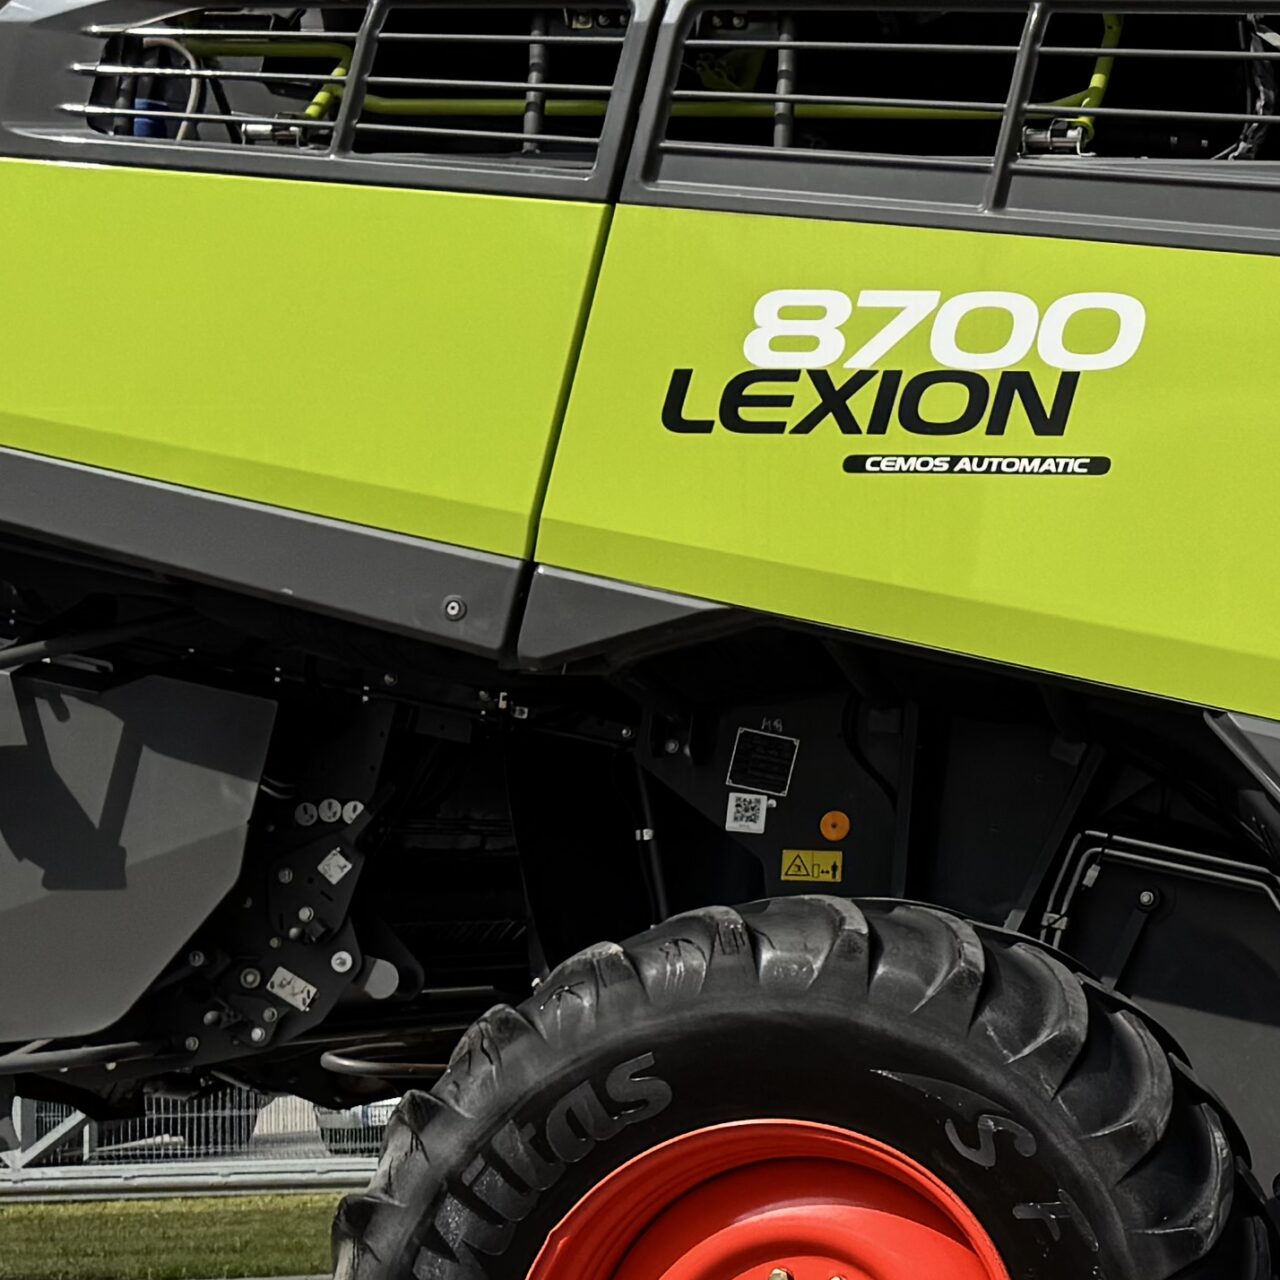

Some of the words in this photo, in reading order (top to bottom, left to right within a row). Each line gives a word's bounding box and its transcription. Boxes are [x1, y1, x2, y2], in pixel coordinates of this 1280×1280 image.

[742, 289, 1147, 372] 8700
[661, 368, 1081, 436] LEXION
[864, 456, 951, 472] CEMOS
[953, 457, 1091, 473] AUTOMATIC
